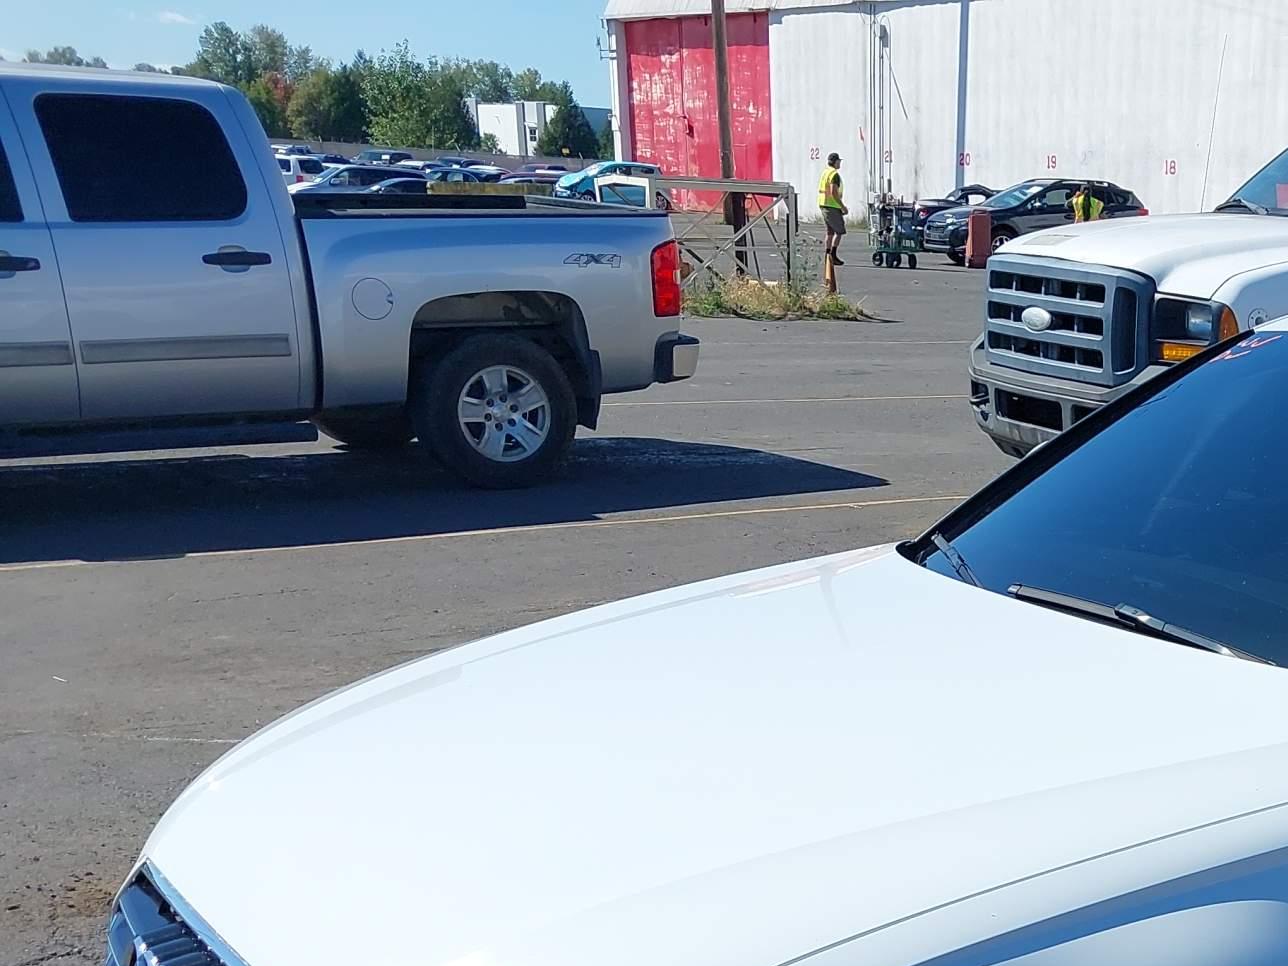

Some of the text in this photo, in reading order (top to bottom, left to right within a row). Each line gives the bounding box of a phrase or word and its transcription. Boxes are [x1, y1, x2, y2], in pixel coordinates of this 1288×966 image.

[810, 147, 820, 160] 22
[959, 152, 971, 166] 20
[1046, 154, 1057, 169] 19
[1164, 159, 1177, 175] 18
